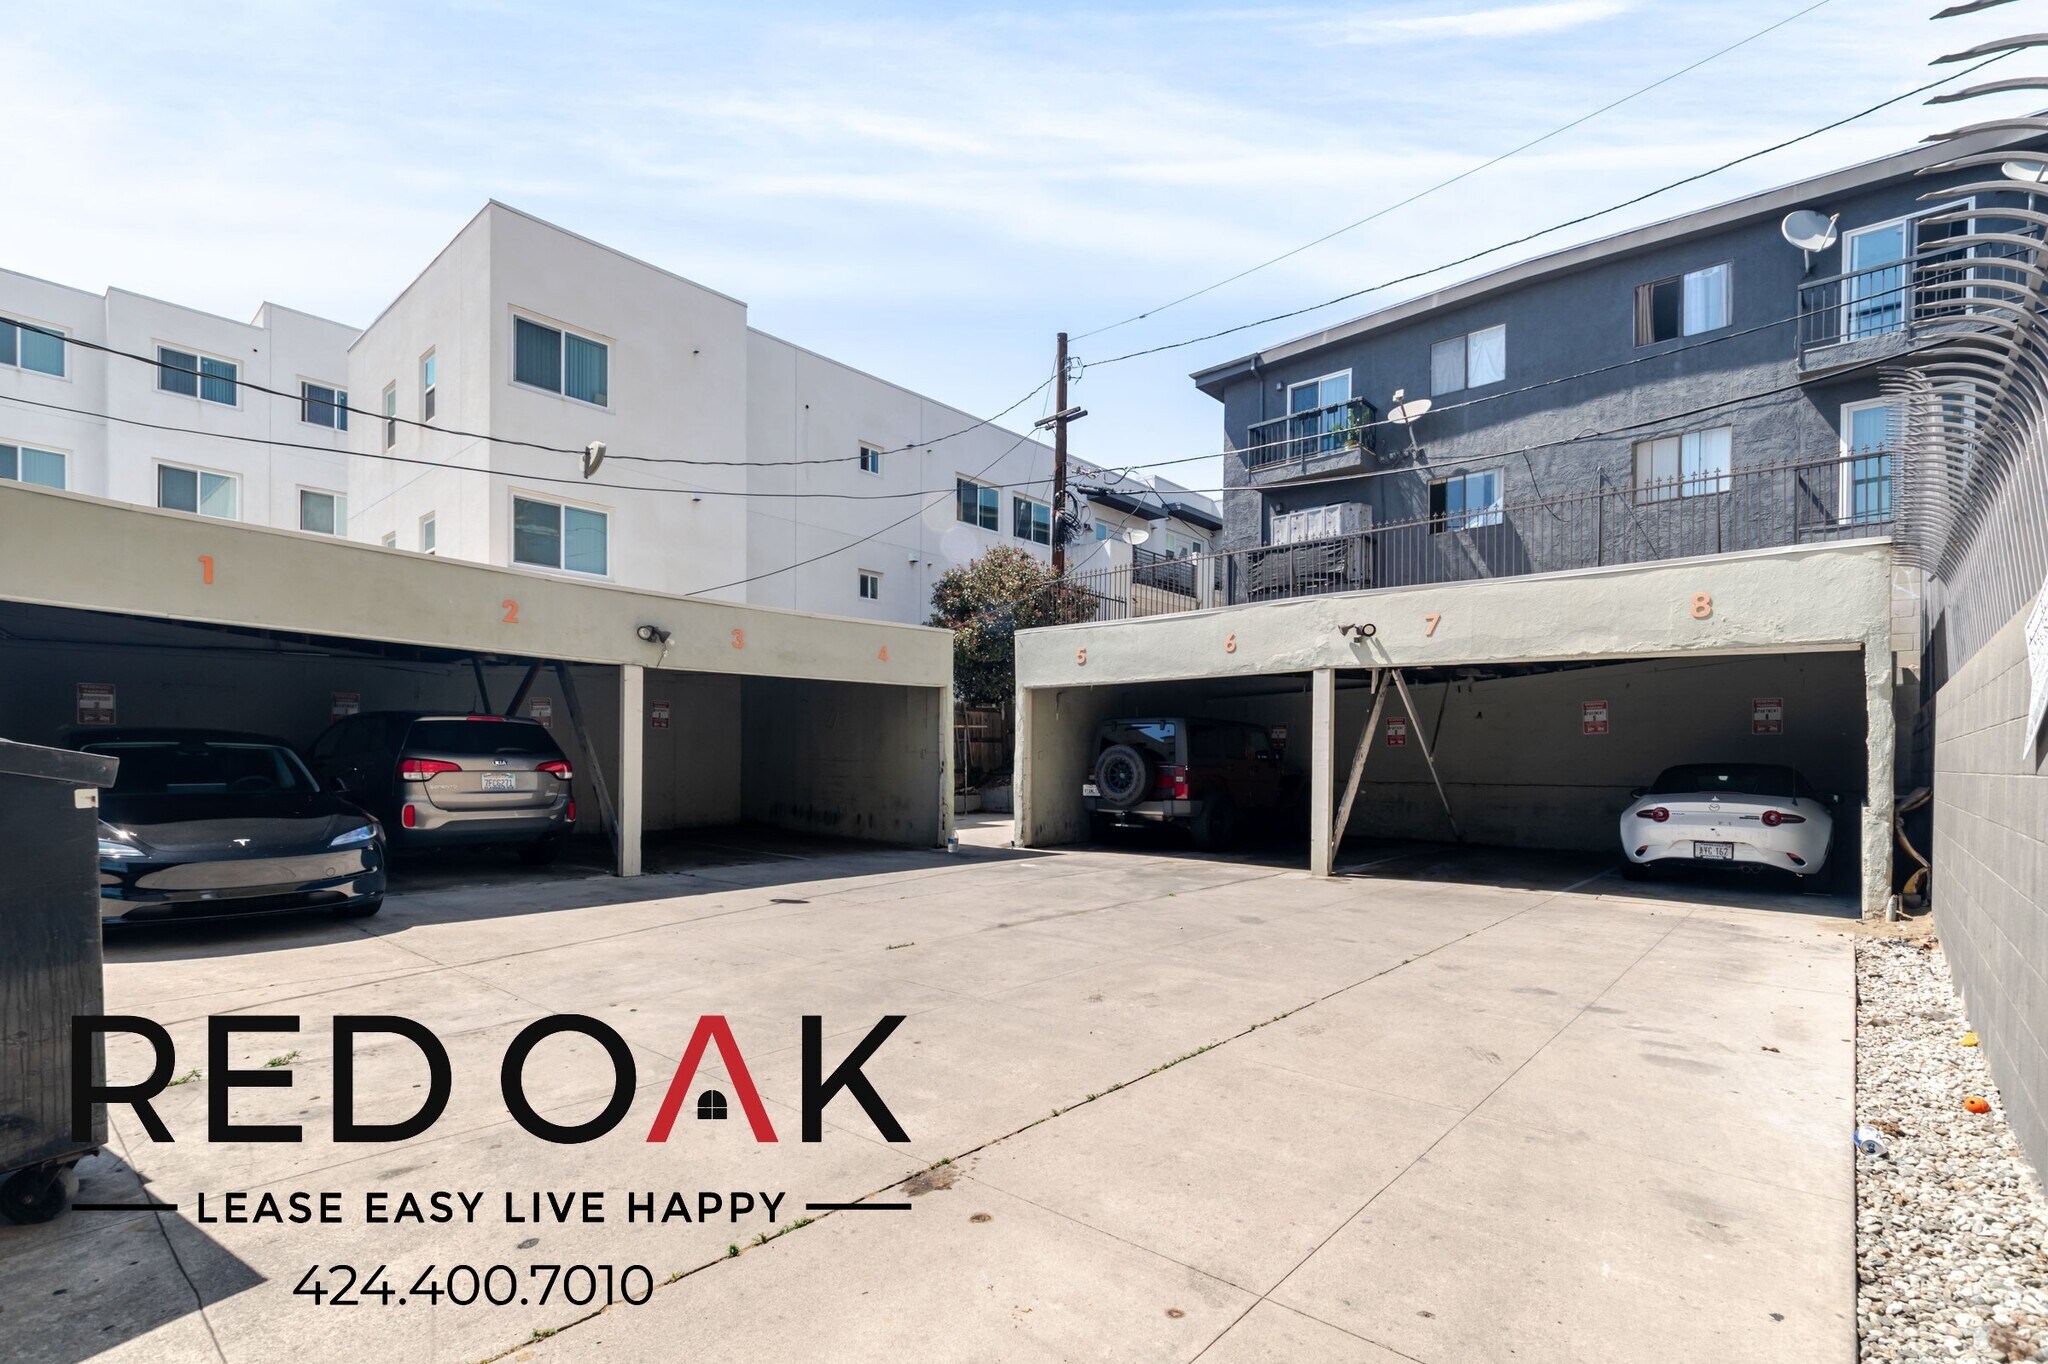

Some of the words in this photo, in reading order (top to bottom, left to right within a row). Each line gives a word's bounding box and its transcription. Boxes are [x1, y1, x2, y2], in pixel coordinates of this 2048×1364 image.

[198, 555, 213, 585] 1
[502, 600, 519, 624] 2
[1692, 593, 1710, 618] 8
[1426, 614, 1441, 637] 7
[731, 629, 745, 649] 3
[1226, 634, 1237, 653] 6
[878, 645, 889, 662] 4
[1077, 648, 1086, 666] 5
